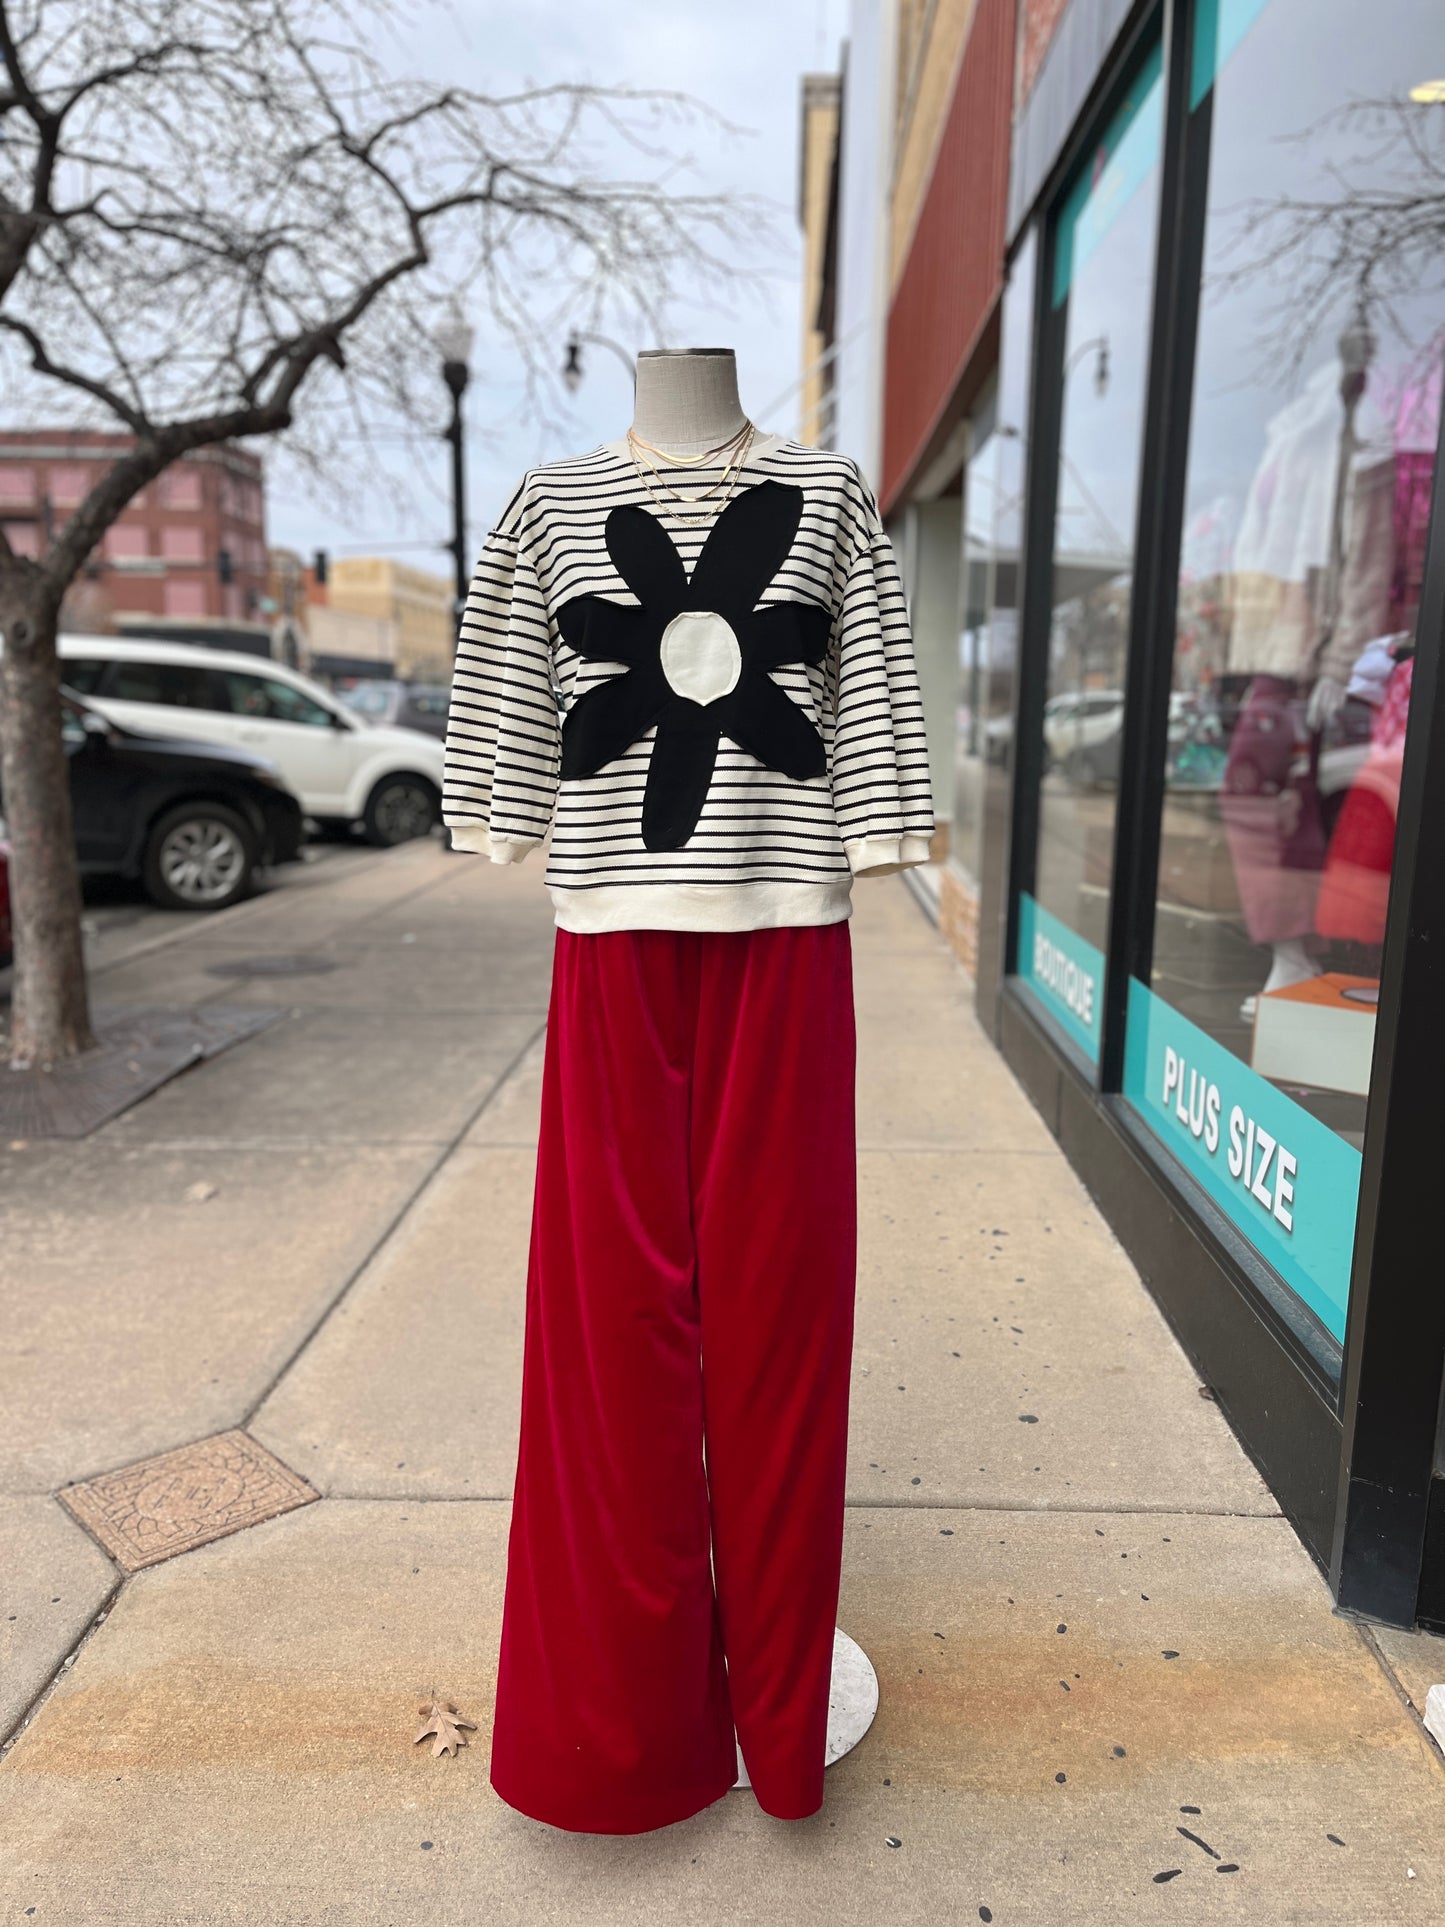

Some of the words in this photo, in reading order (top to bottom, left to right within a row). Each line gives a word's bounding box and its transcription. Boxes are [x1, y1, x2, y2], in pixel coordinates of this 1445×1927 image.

[1033, 933, 1093, 1023] BOUTIQUE
[1163, 1046, 1221, 1152] PLUS
[1228, 1105, 1297, 1231] SIZE
